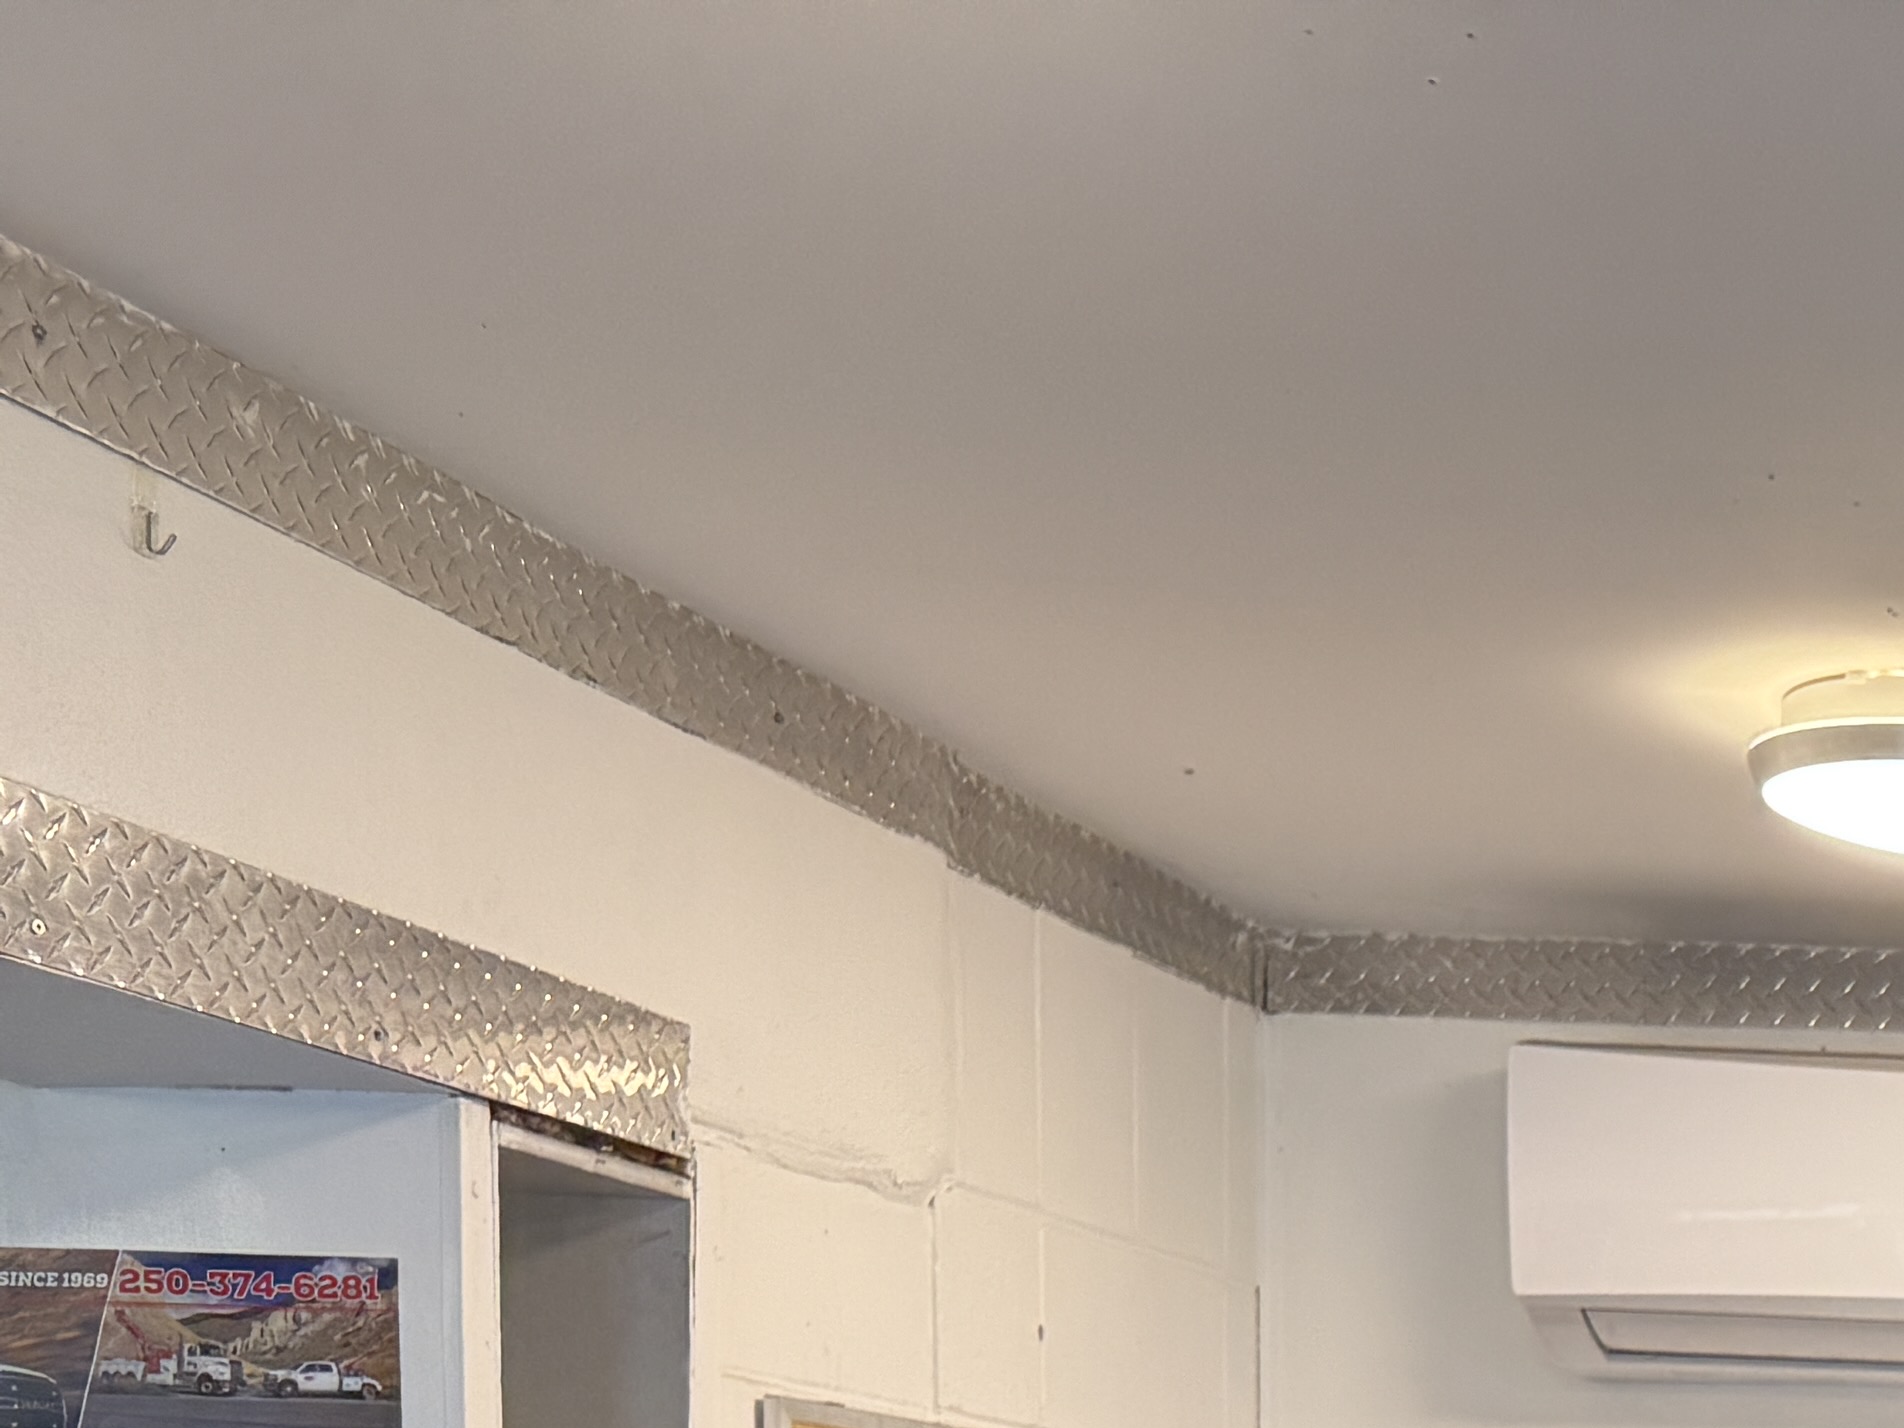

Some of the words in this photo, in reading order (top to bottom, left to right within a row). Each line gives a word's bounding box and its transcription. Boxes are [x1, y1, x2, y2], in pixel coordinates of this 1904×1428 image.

[0, 1271, 58, 1288] SINCE
[62, 1272, 109, 1289] 1969
[118, 1268, 381, 1301] 250-374-6281
